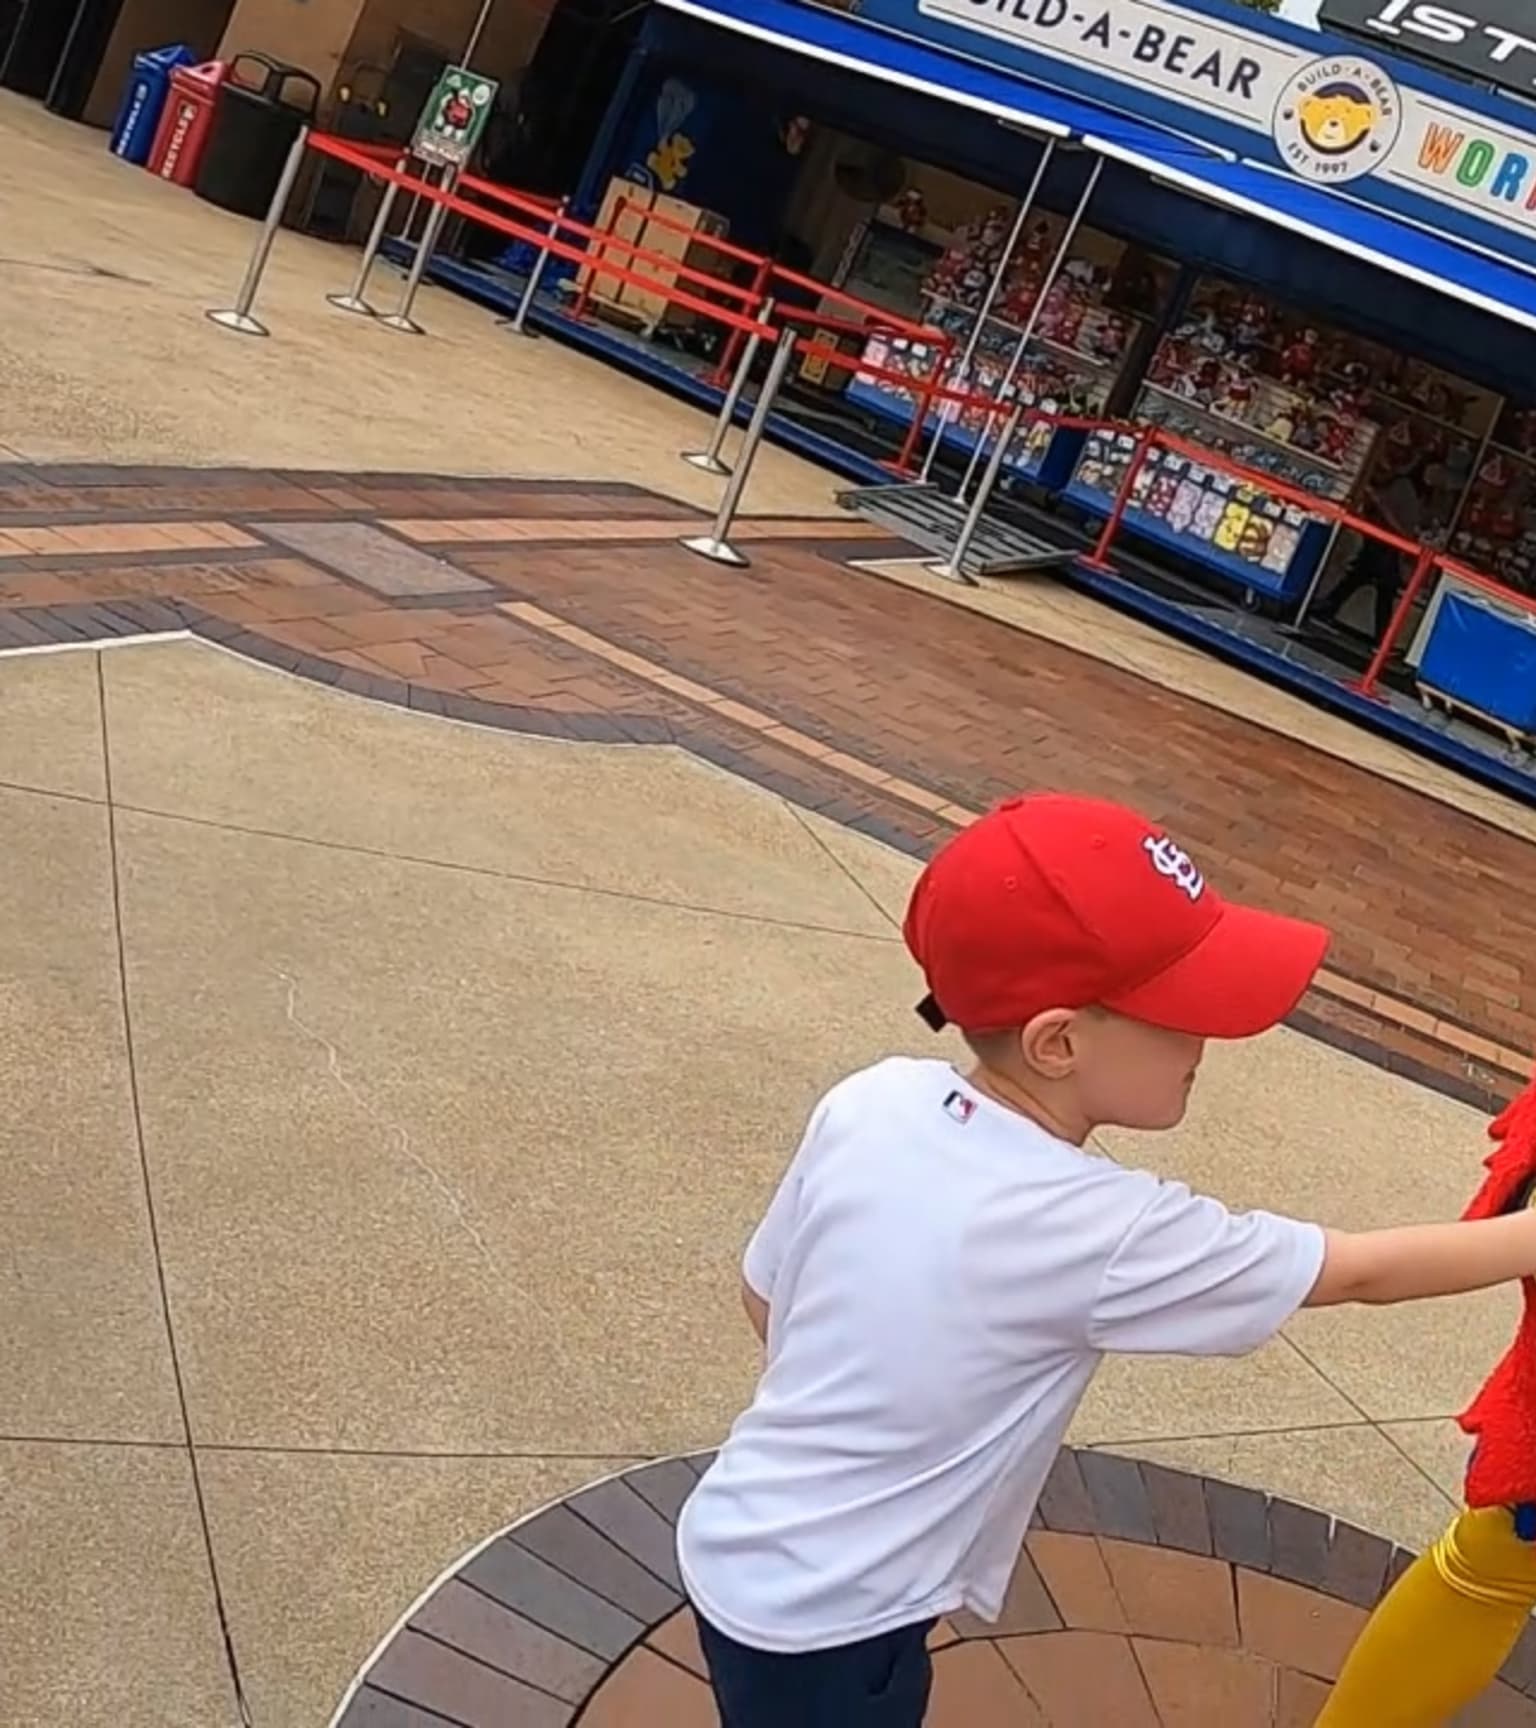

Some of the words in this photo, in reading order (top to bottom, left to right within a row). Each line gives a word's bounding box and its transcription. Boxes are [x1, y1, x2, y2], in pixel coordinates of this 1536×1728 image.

[968, 0, 1261, 99] LD-A-BEAR
[1287, 142, 1310, 163] EST
[1314, 161, 1348, 174] 1997
